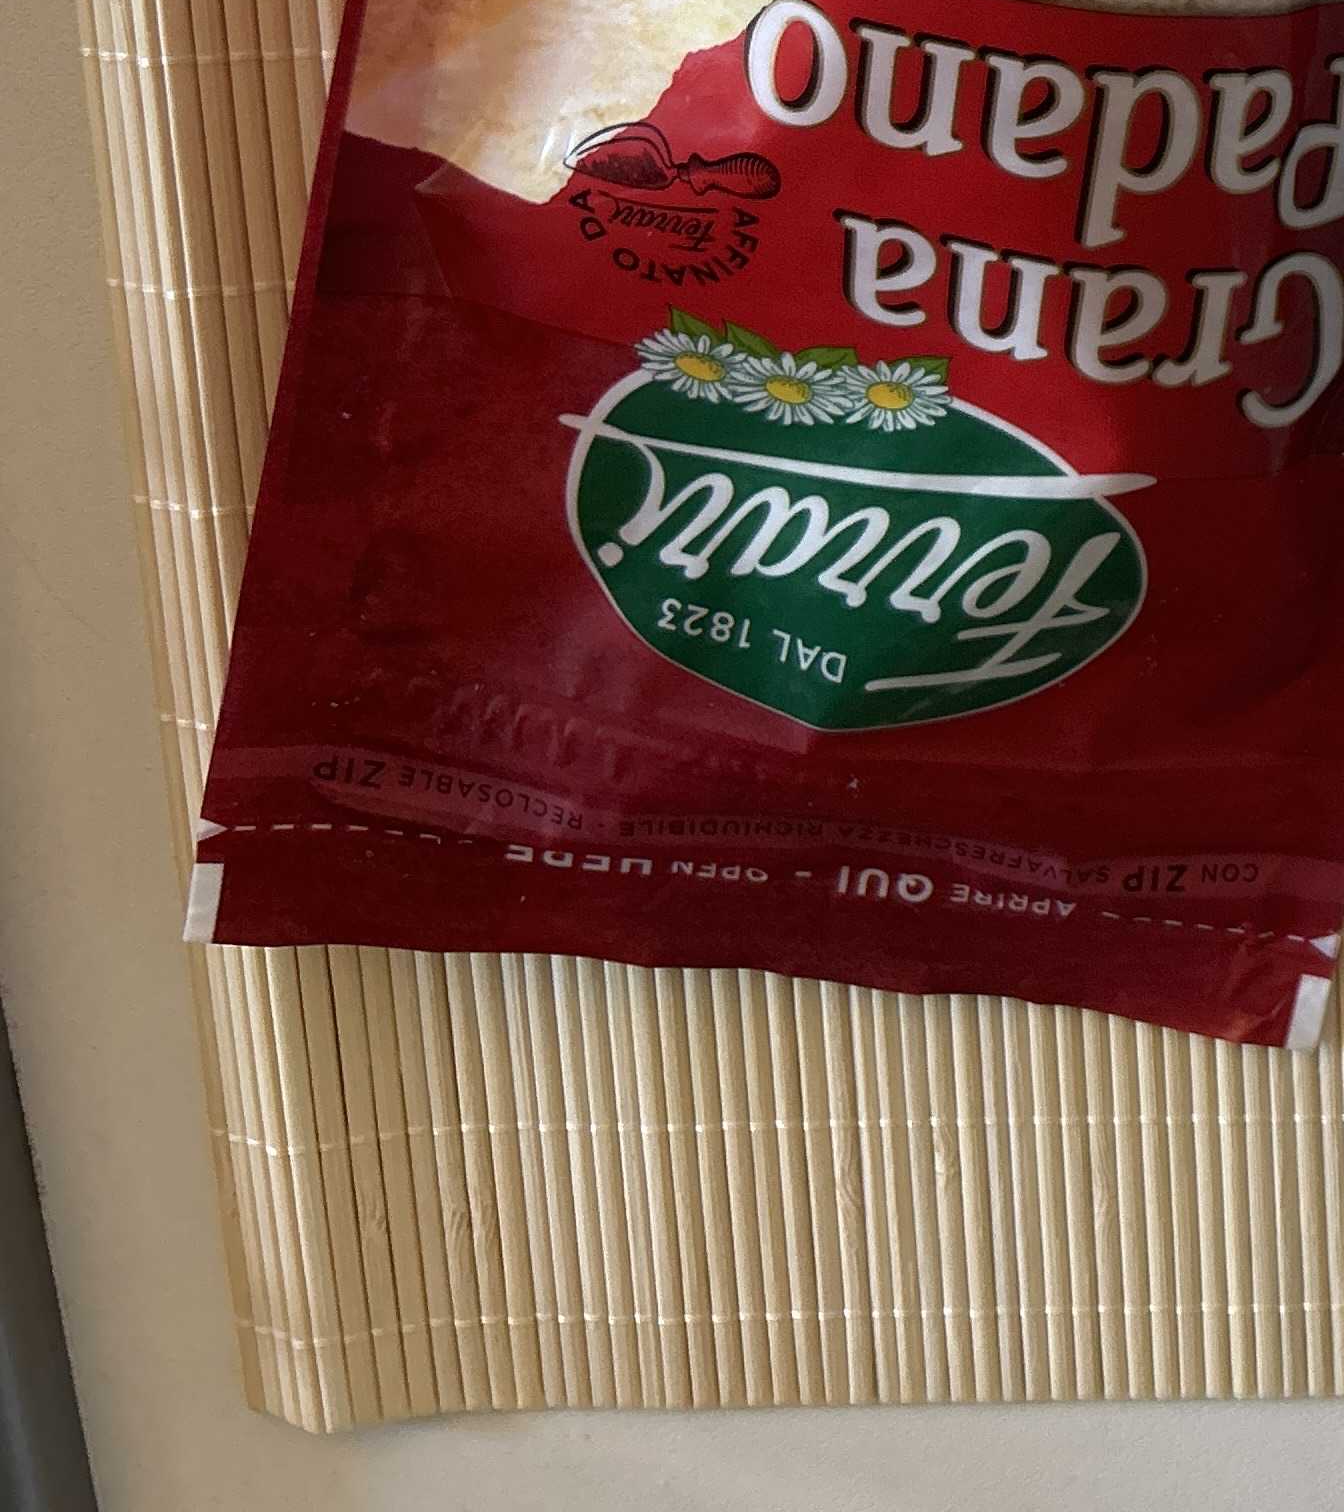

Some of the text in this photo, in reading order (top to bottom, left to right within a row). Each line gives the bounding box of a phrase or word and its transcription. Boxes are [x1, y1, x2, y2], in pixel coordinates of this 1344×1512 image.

[568, 189, 759, 287] AFFINATO DA
[599, 191, 718, 253] Ferrari
[558, 413, 1139, 694] Ferrari
[654, 598, 847, 684] DAL 1823
[311, 757, 385, 790] ZIP
[399, 765, 583, 831] RECLOSABLE
[618, 818, 823, 839] RICHIUDIBILE
[835, 865, 934, 904] QUI
[1122, 863, 1188, 892] ZIP
[1201, 863, 1259, 884] CON
[949, 883, 1077, 918] APRIRE
